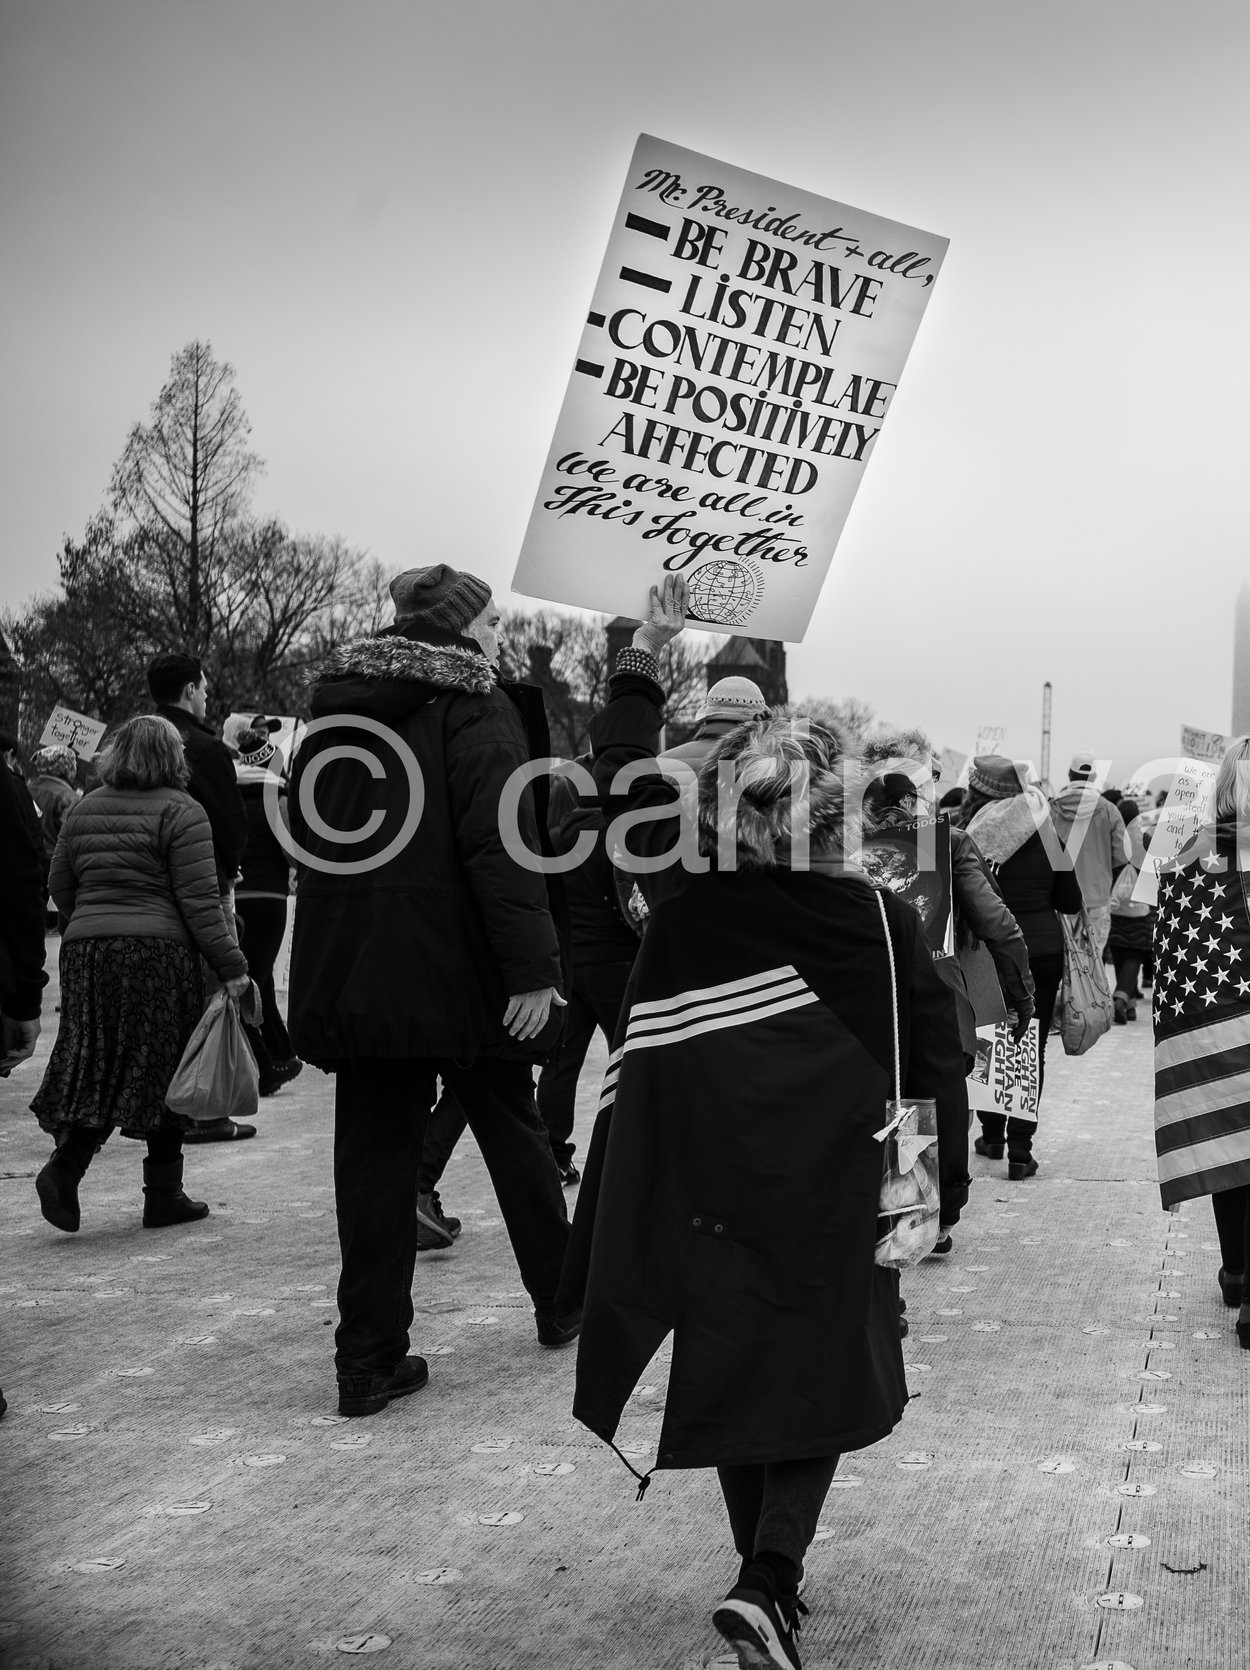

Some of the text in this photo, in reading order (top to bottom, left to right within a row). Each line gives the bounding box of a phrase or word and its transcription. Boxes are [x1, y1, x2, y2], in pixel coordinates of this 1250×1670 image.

[687, 185, 859, 251] President
[669, 217, 883, 318] BE BRAVE
[679, 272, 842, 358] LISTEN
[603, 357, 880, 462] BE POSITIVELY
[556, 451, 804, 527] We are all in
[598, 412, 818, 495] AFFECTED
[543, 485, 809, 572] This Together
[905, 815, 945, 831] TODOS
[1167, 824, 1185, 836] and
[1175, 788, 1195, 800] open
[1004, 1026, 1015, 1112] UMAN
[1028, 1026, 1037, 1113] WOMEN
